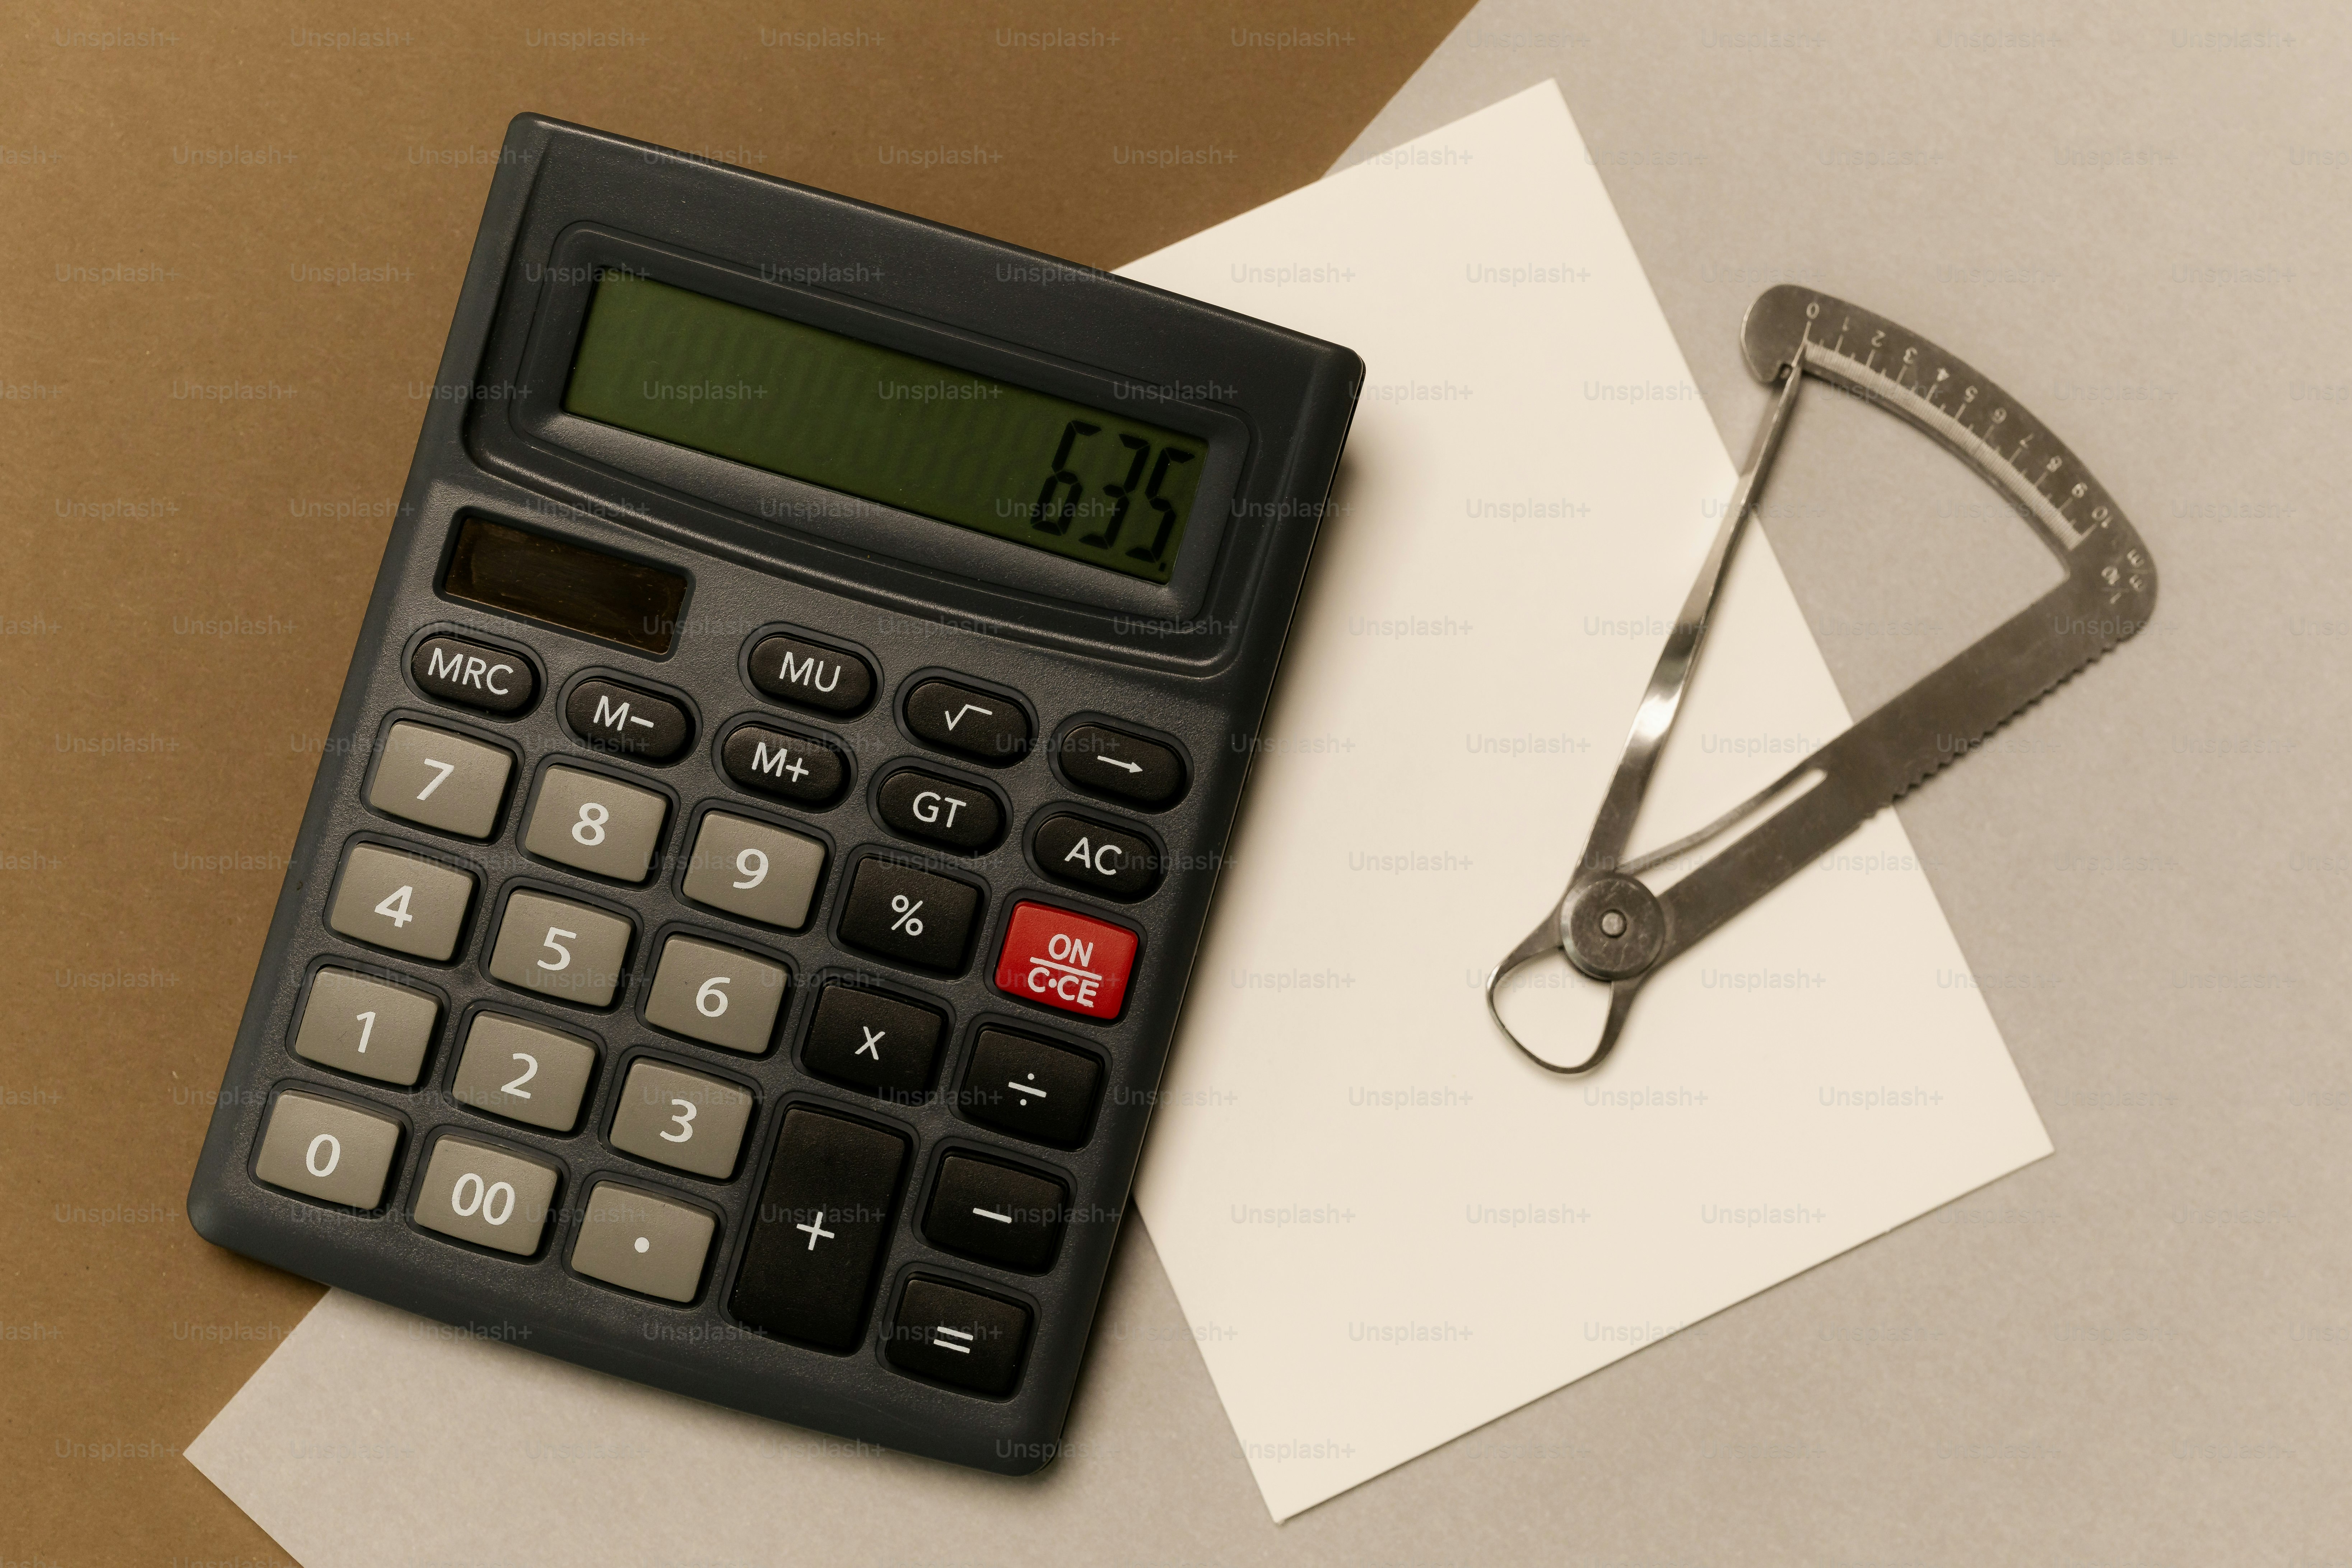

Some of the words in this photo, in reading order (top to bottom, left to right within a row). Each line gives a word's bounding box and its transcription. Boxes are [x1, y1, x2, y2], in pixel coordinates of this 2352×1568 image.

[1806, 302, 1820, 319] 0
[1842, 315, 1850, 332] 1
[1871, 329, 1887, 348] 2
[1903, 346, 1918, 364] 3
[1936, 367, 1950, 382] 4
[1964, 385, 1978, 403] 5
[1992, 407, 2007, 424] 6
[2019, 433, 2035, 449] 7
[2046, 455, 2063, 473] 8
[2072, 482, 2088, 499] 9
[2091, 506, 2113, 529] 10
[428, 647, 513, 695] MRC
[779, 652, 841, 692] MU
[416, 758, 455, 800] 7
[751, 742, 809, 782] M+
[572, 802, 609, 846] 8
[913, 792, 967, 828] GT
[733, 848, 769, 889] 9
[1065, 837, 1122, 875] AC
[374, 885, 413, 928] 4
[891, 895, 923, 936] %
[537, 927, 577, 971] 5
[1048, 934, 1093, 967] ON
[696, 977, 731, 1017] 6
[357, 1011, 376, 1053] 1
[500, 1053, 538, 1099] 2
[1008, 1073, 1046, 1106] ÷
[660, 1099, 697, 1143] 3
[306, 1134, 341, 1177] 0
[452, 1173, 515, 1225] 00
[796, 1211, 834, 1250] +
[933, 1326, 973, 1353] =
